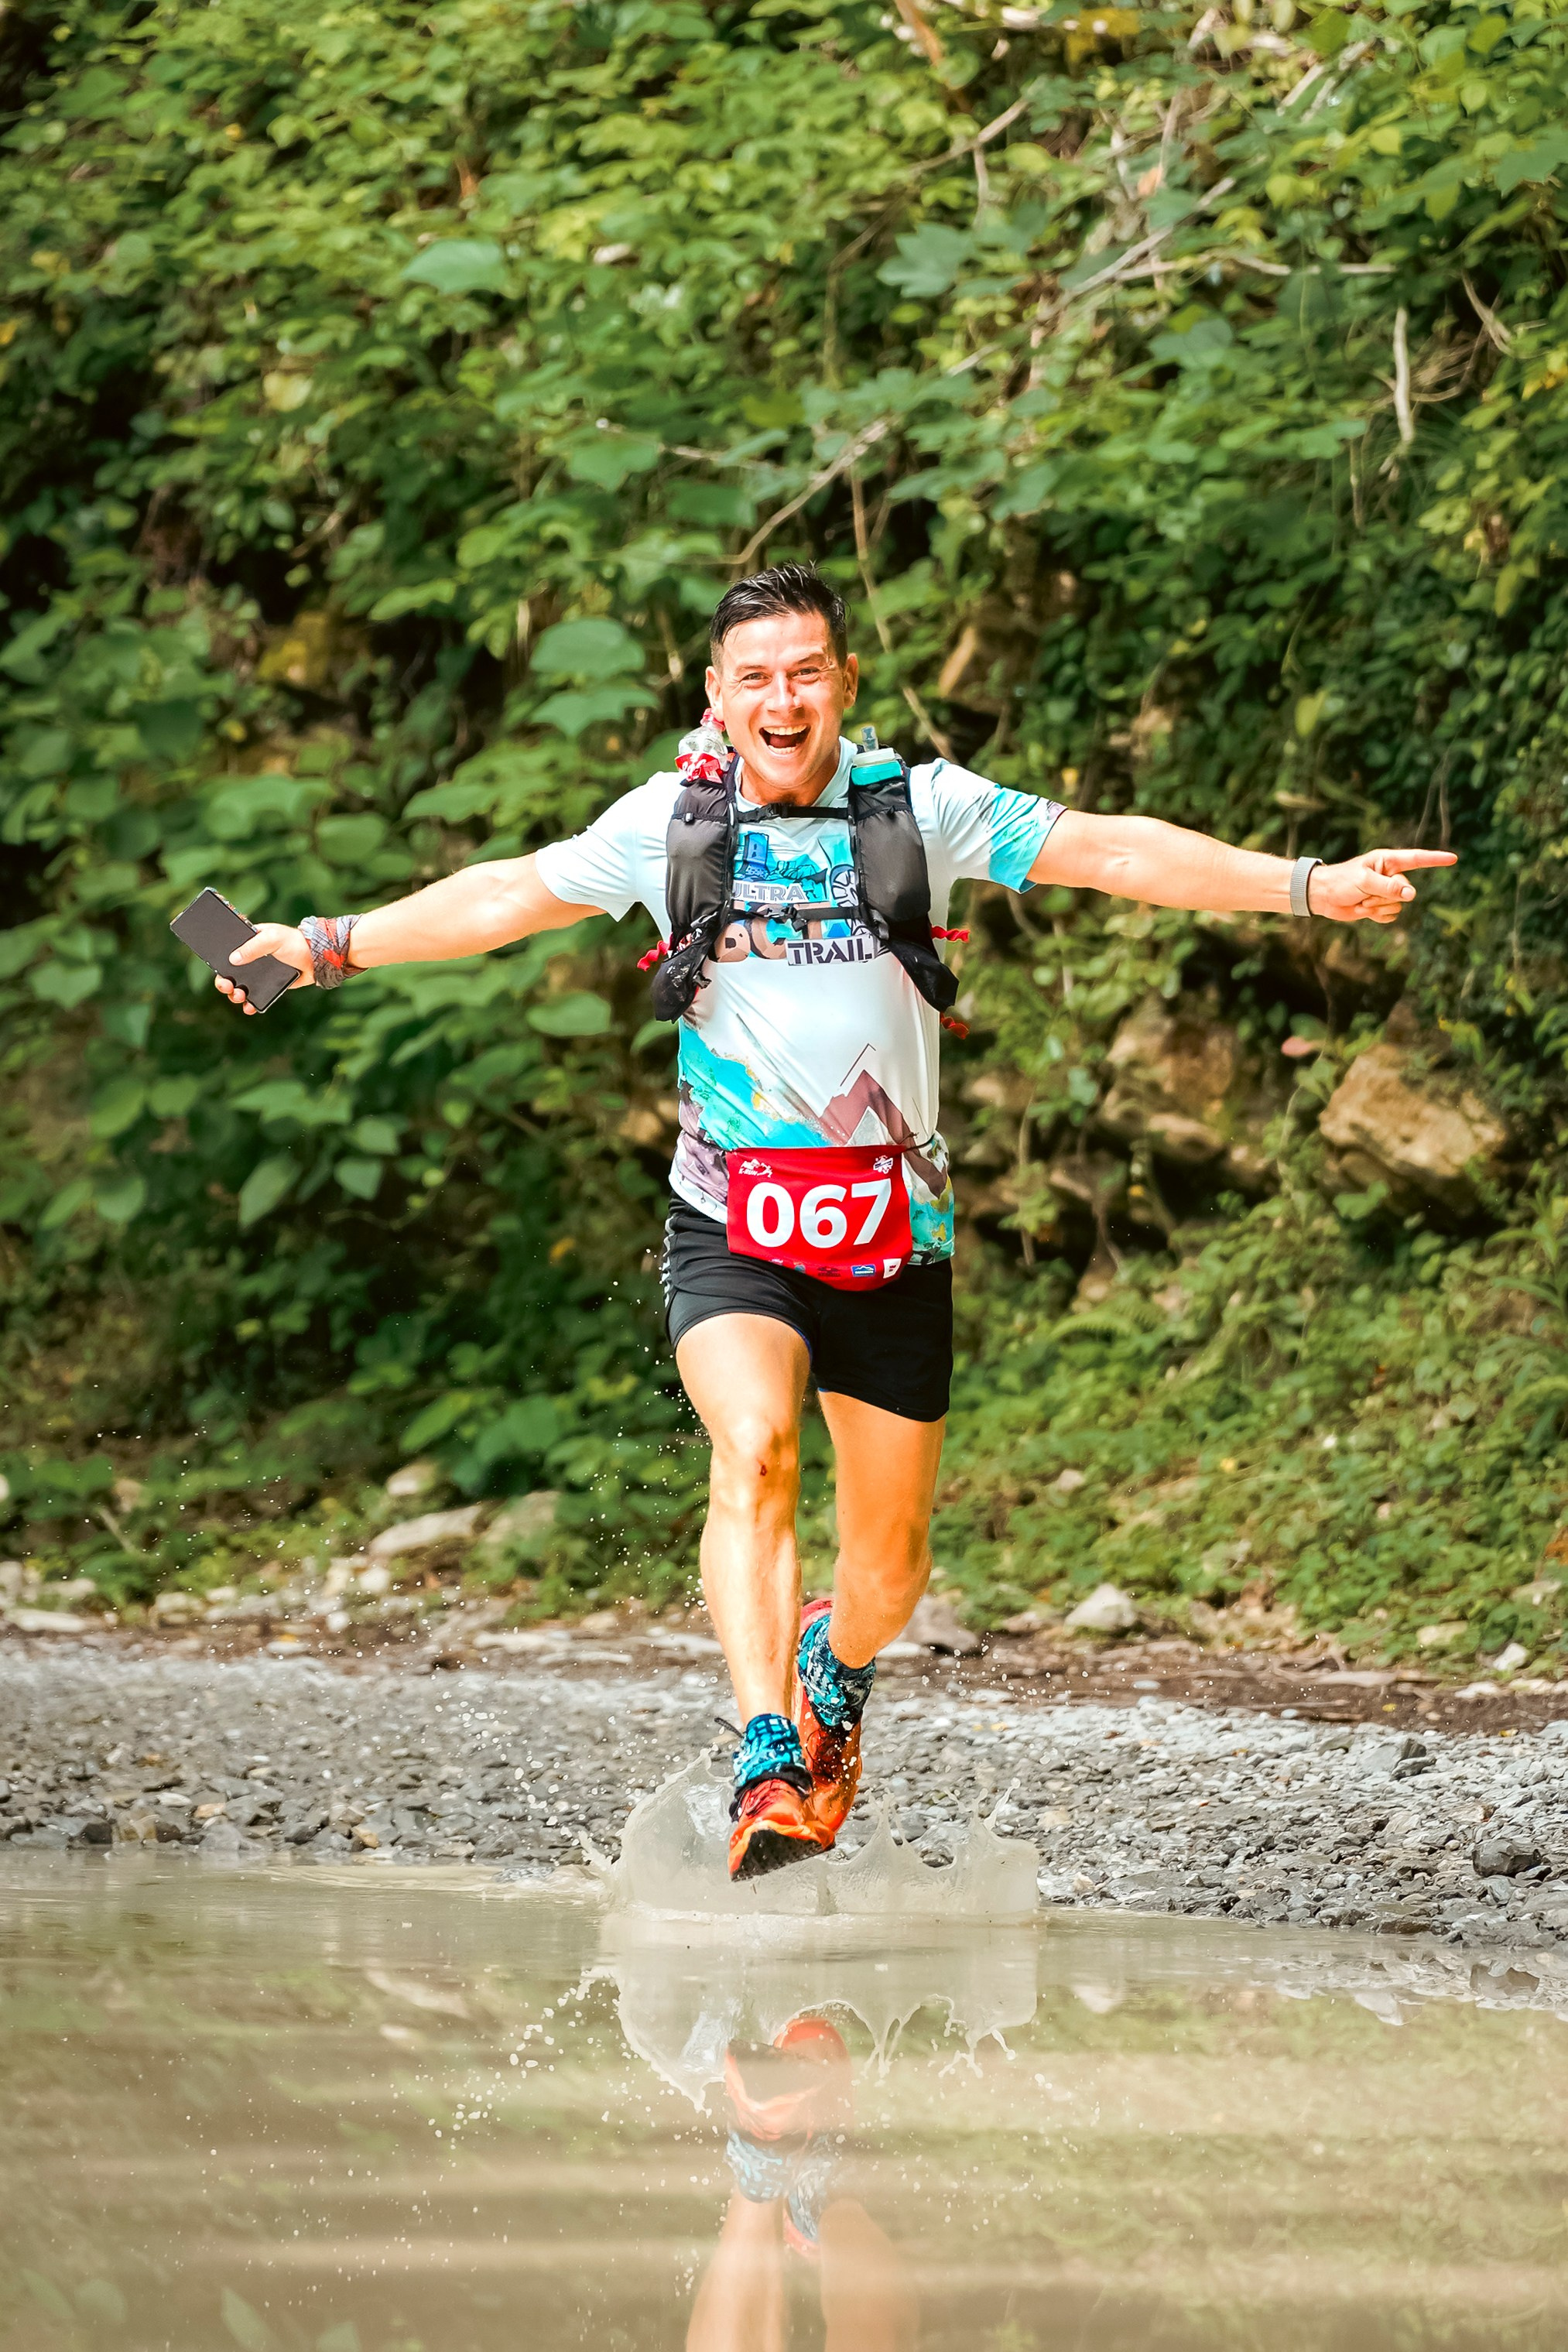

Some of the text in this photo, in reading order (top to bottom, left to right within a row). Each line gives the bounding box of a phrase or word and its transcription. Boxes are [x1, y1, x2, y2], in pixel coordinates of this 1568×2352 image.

[733, 882, 806, 901] ULTRA
[787, 937, 872, 964] TRAIL
[747, 1178, 892, 1248] 067
